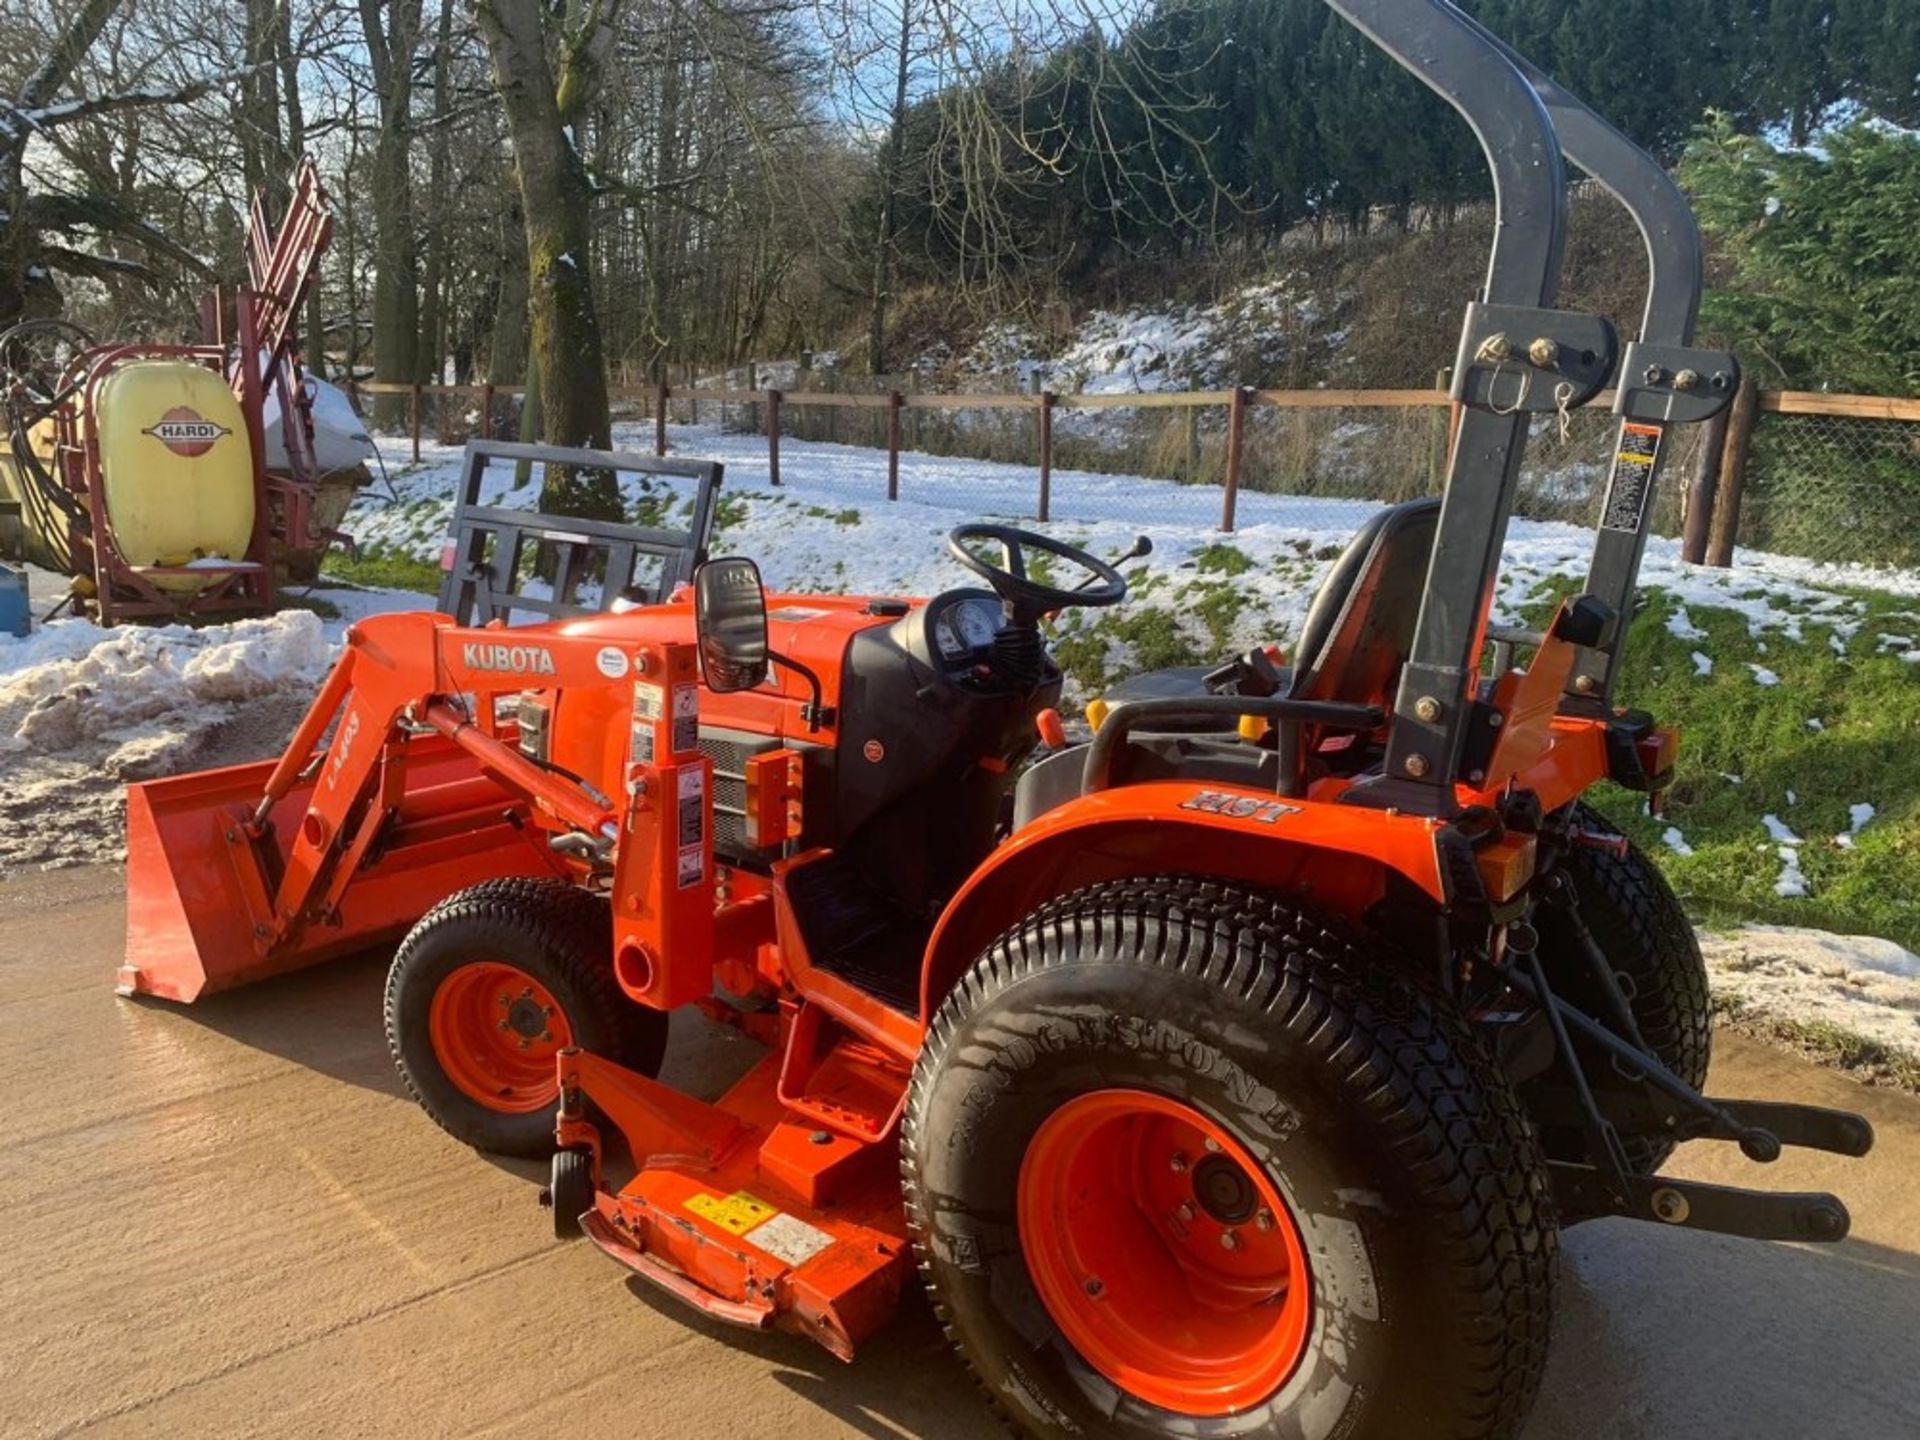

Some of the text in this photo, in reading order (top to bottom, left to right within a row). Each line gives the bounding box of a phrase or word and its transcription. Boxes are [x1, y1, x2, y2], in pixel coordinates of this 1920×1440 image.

[162, 425, 214, 437] HARDI
[463, 643, 557, 676] KUBOTA
[1178, 790, 1305, 824] HST
